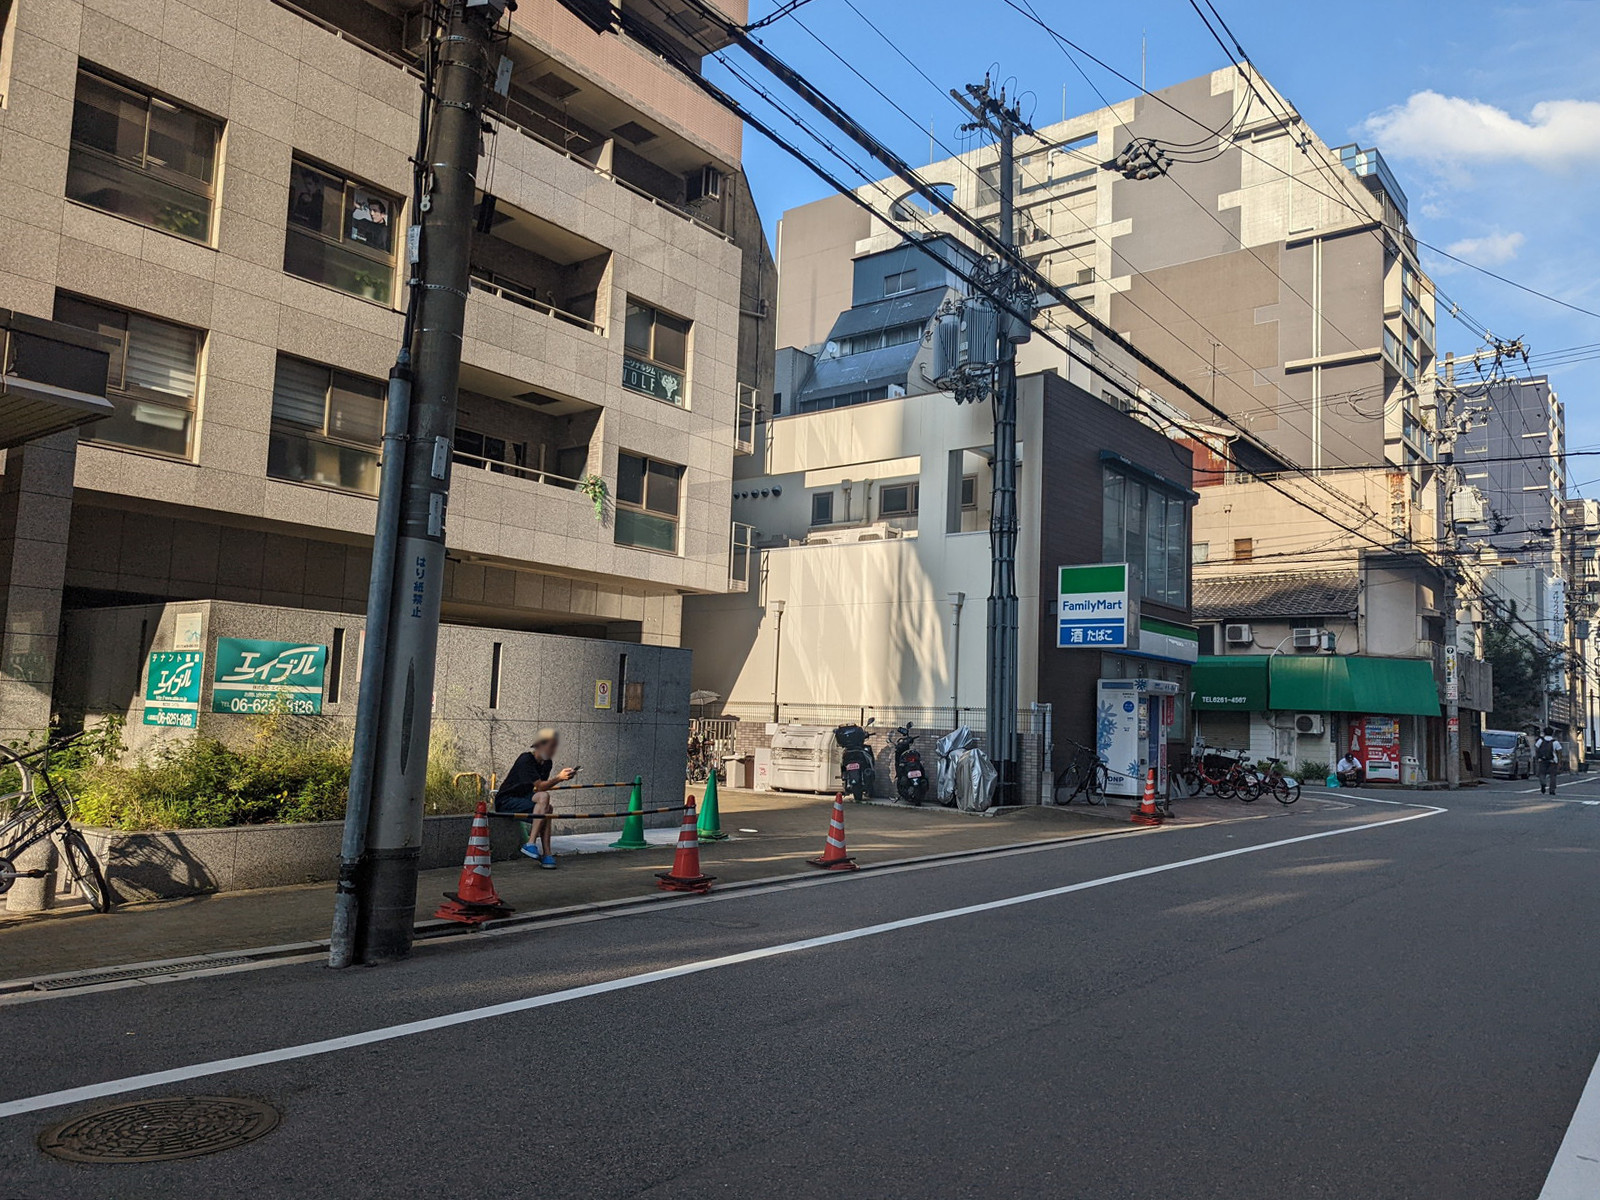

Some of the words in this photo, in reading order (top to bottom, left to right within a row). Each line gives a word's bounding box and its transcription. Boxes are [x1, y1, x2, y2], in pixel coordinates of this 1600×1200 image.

[624, 360, 656, 375] ーソナルジム
[623, 369, 656, 391] OLF
[411, 556, 426, 618] はり紙禁止
[1063, 599, 1123, 613] FamilyMart
[1070, 628, 1083, 643] 酒
[1087, 629, 1113, 642] たばこ
[221, 646, 320, 683] エイブル
[153, 662, 194, 695] エイブル
